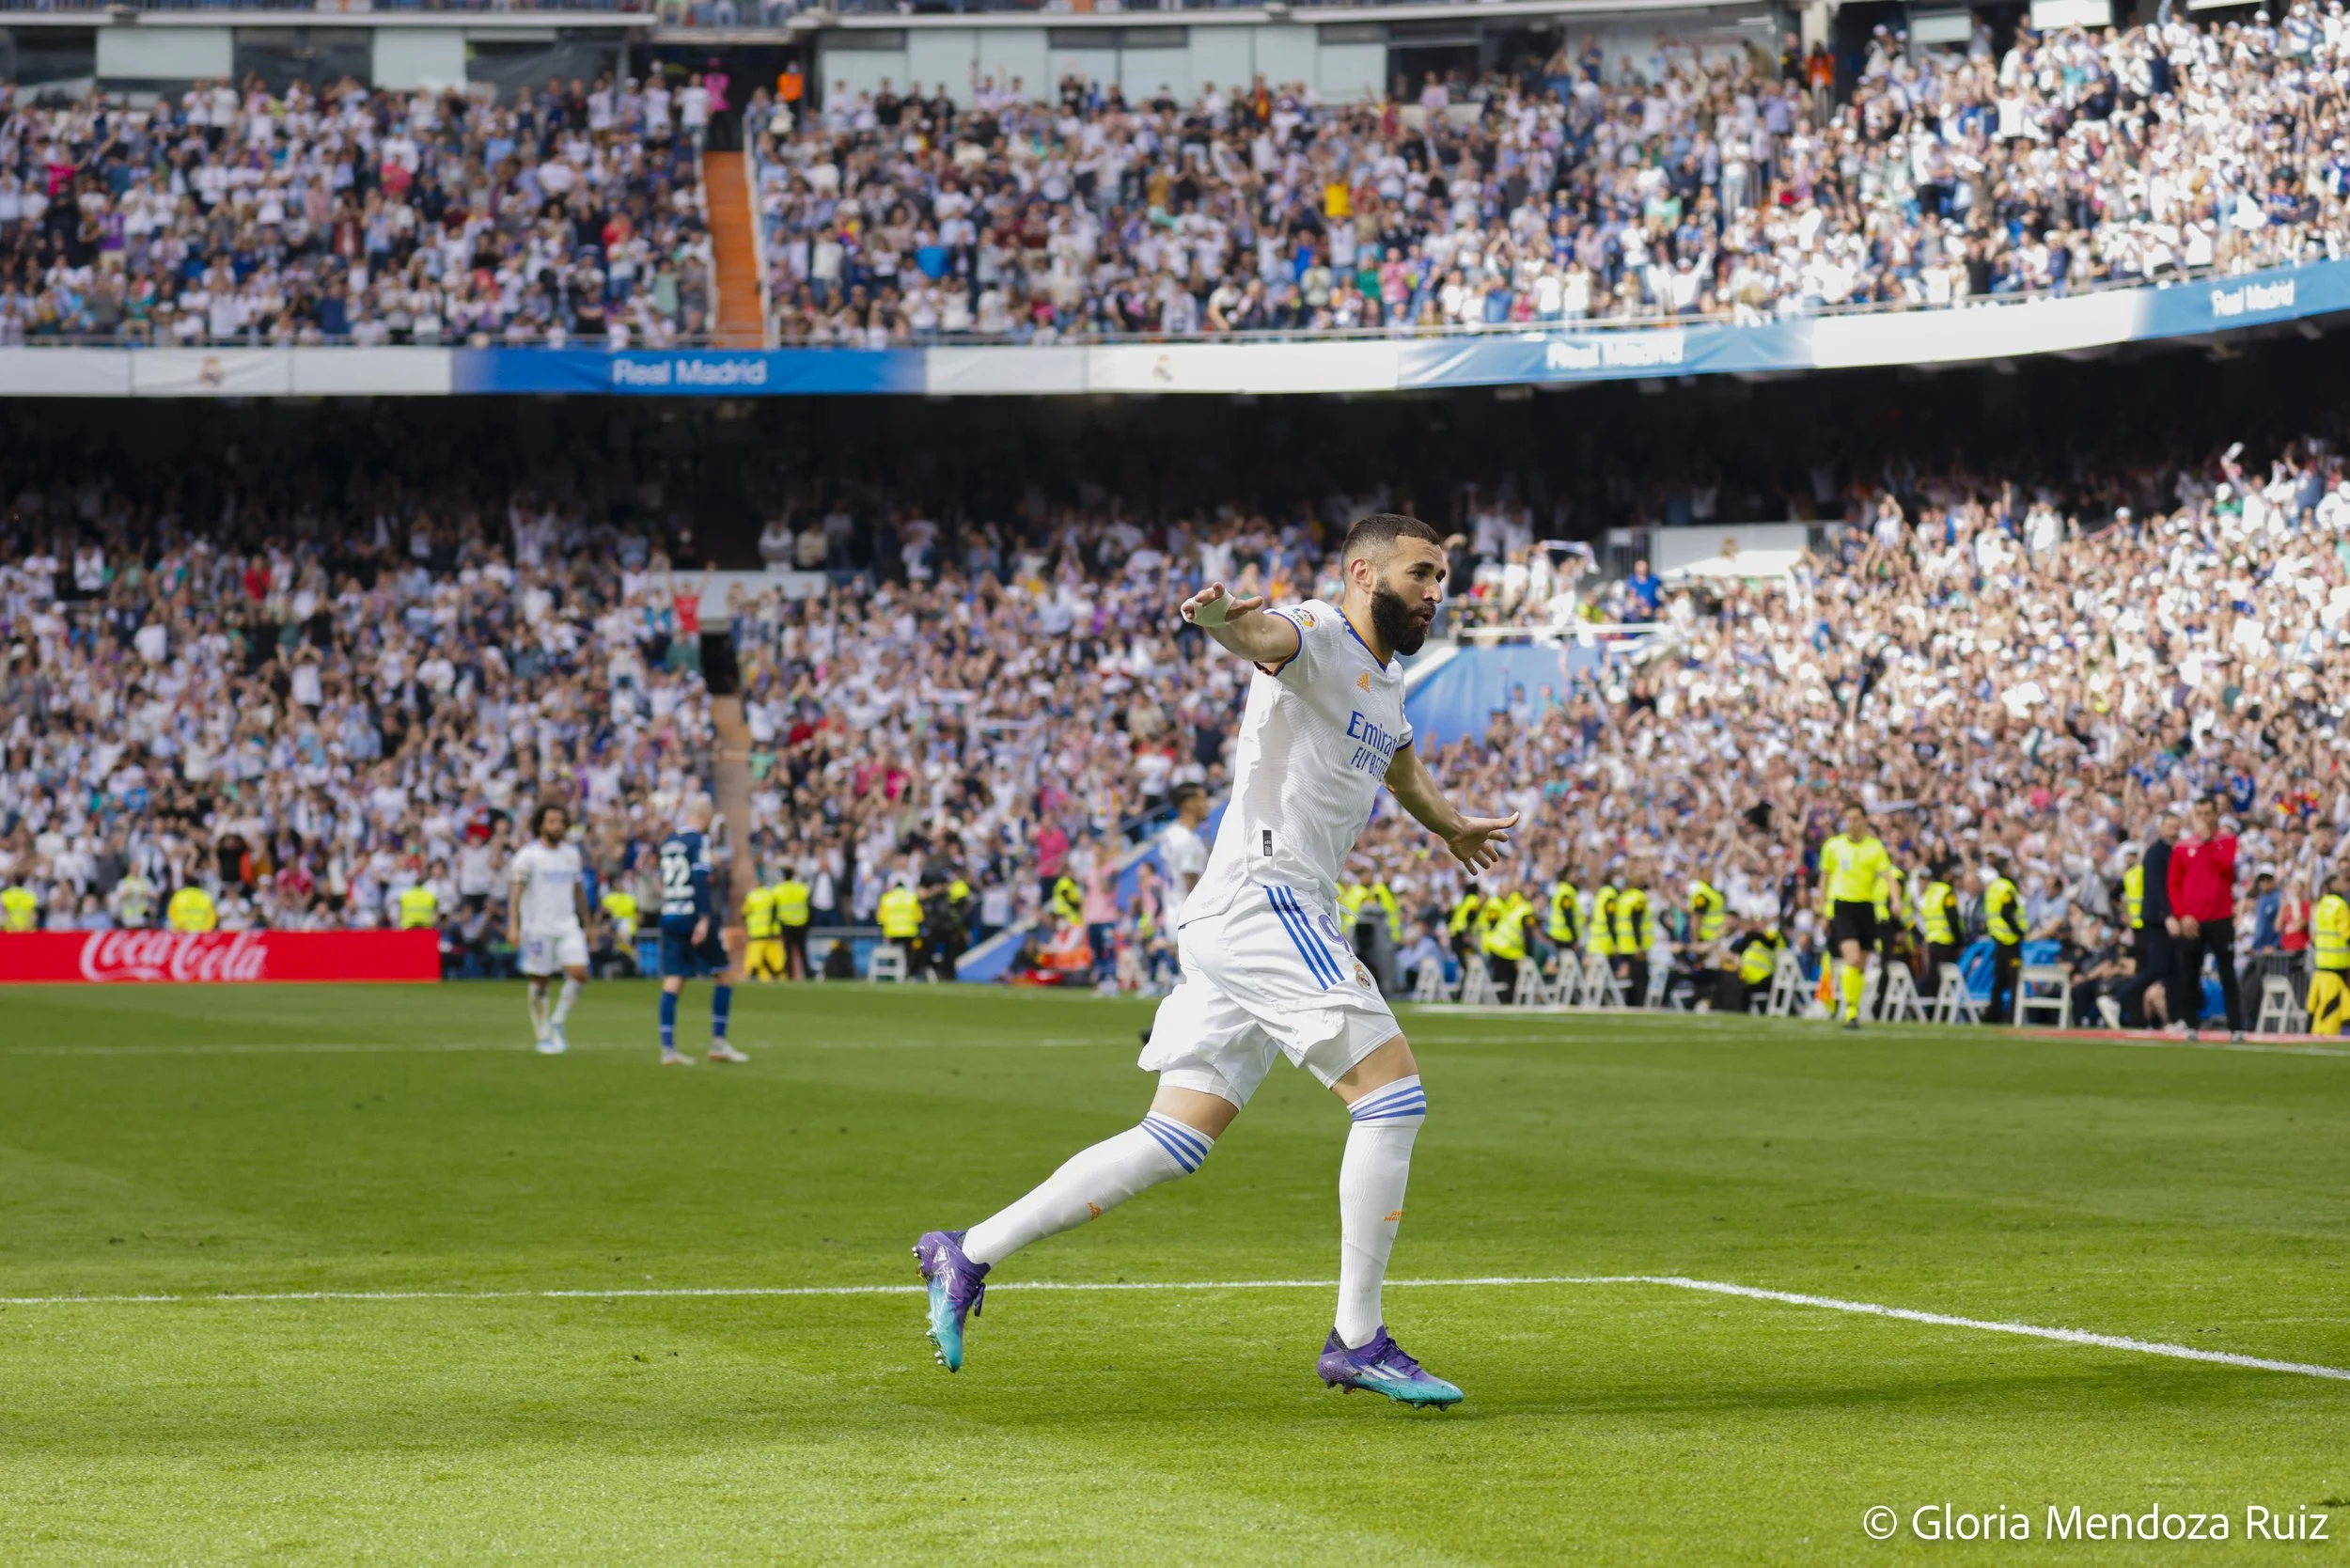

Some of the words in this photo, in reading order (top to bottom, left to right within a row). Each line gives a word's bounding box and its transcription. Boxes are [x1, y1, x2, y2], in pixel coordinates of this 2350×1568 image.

[613, 359, 671, 385] Real
[676, 359, 767, 385] Madrid
[1351, 746, 1371, 770] FLY
